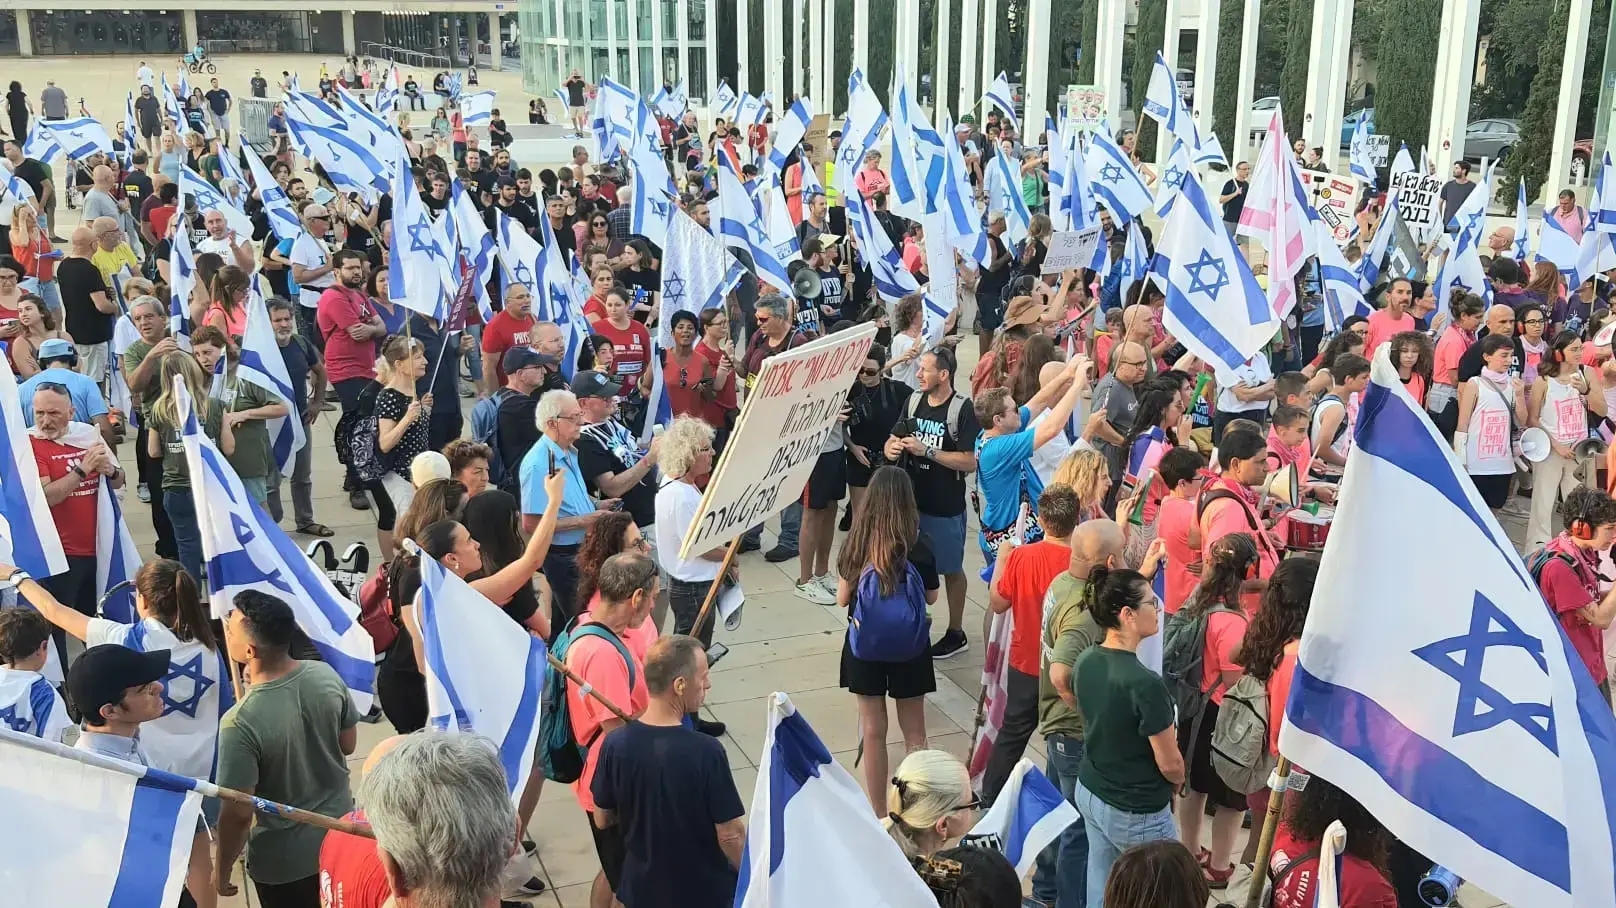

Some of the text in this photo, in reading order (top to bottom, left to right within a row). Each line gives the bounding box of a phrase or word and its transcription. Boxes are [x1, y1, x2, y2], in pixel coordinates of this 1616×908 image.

[1404, 175, 1419, 188] היא
[1419, 175, 1443, 194] ישראל
[1399, 189, 1432, 207] נחלת
[694, 474, 788, 545] לדיקטטורה
